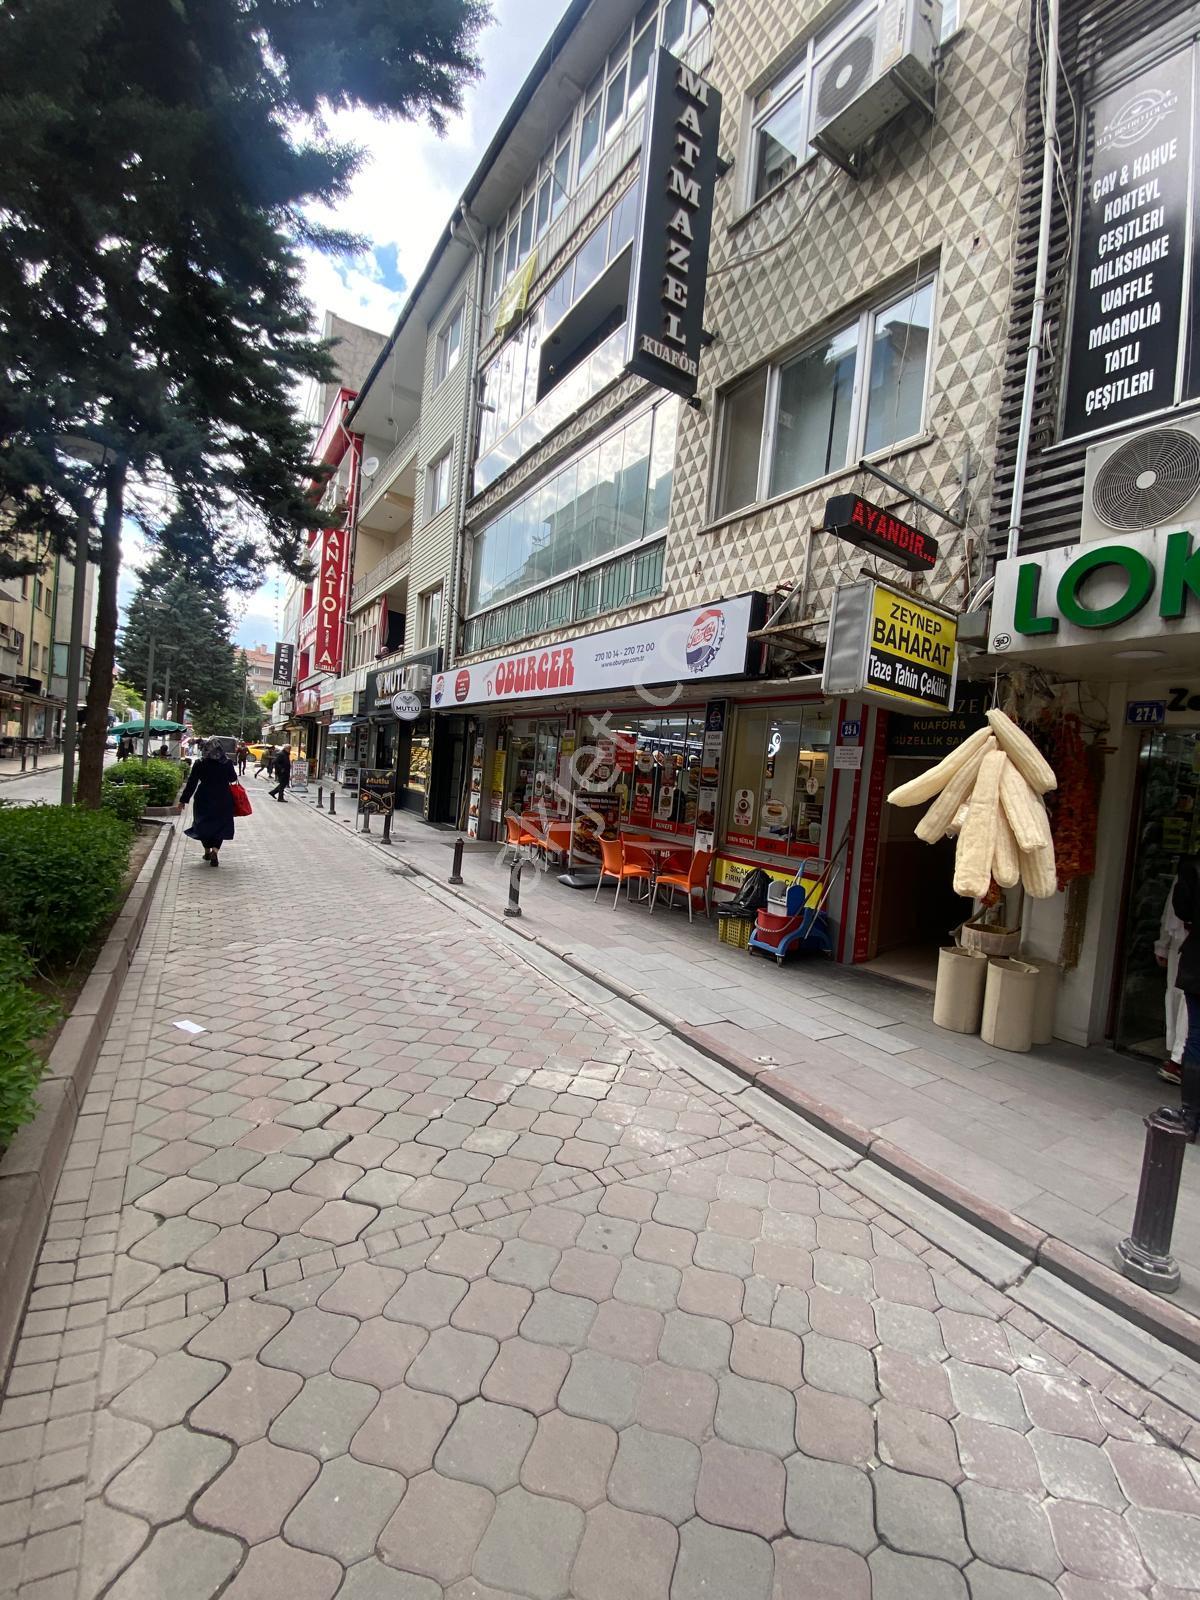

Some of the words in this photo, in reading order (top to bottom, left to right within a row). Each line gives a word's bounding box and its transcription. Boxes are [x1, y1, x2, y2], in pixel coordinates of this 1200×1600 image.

[664, 65, 710, 345] MATMAZEL
[1093, 170, 1117, 203] ÇAY
[1119, 165, 1129, 186] &
[1104, 178, 1161, 224] KOKTEYL
[1101, 272, 1154, 314] WAFFLE
[641, 334, 698, 377] KUAFÖR
[1105, 341, 1140, 374] TATLI
[890, 602, 942, 635] ZEYNEP
[594, 652, 605, 662] 270
[606, 650, 612, 660] 10
[613, 649, 619, 659] 14
[624, 646, 635, 656] 270
[637, 644, 645, 654] 72
[646, 642, 655, 652] 00
[873, 617, 951, 667] BAHARAT
[495, 647, 575, 696] OBURGER
[870, 655, 892, 682] Taze
[895, 662, 919, 691] Tahin
[920, 671, 947, 698] Çekilir
[725, 873, 741, 884] FIRIN
